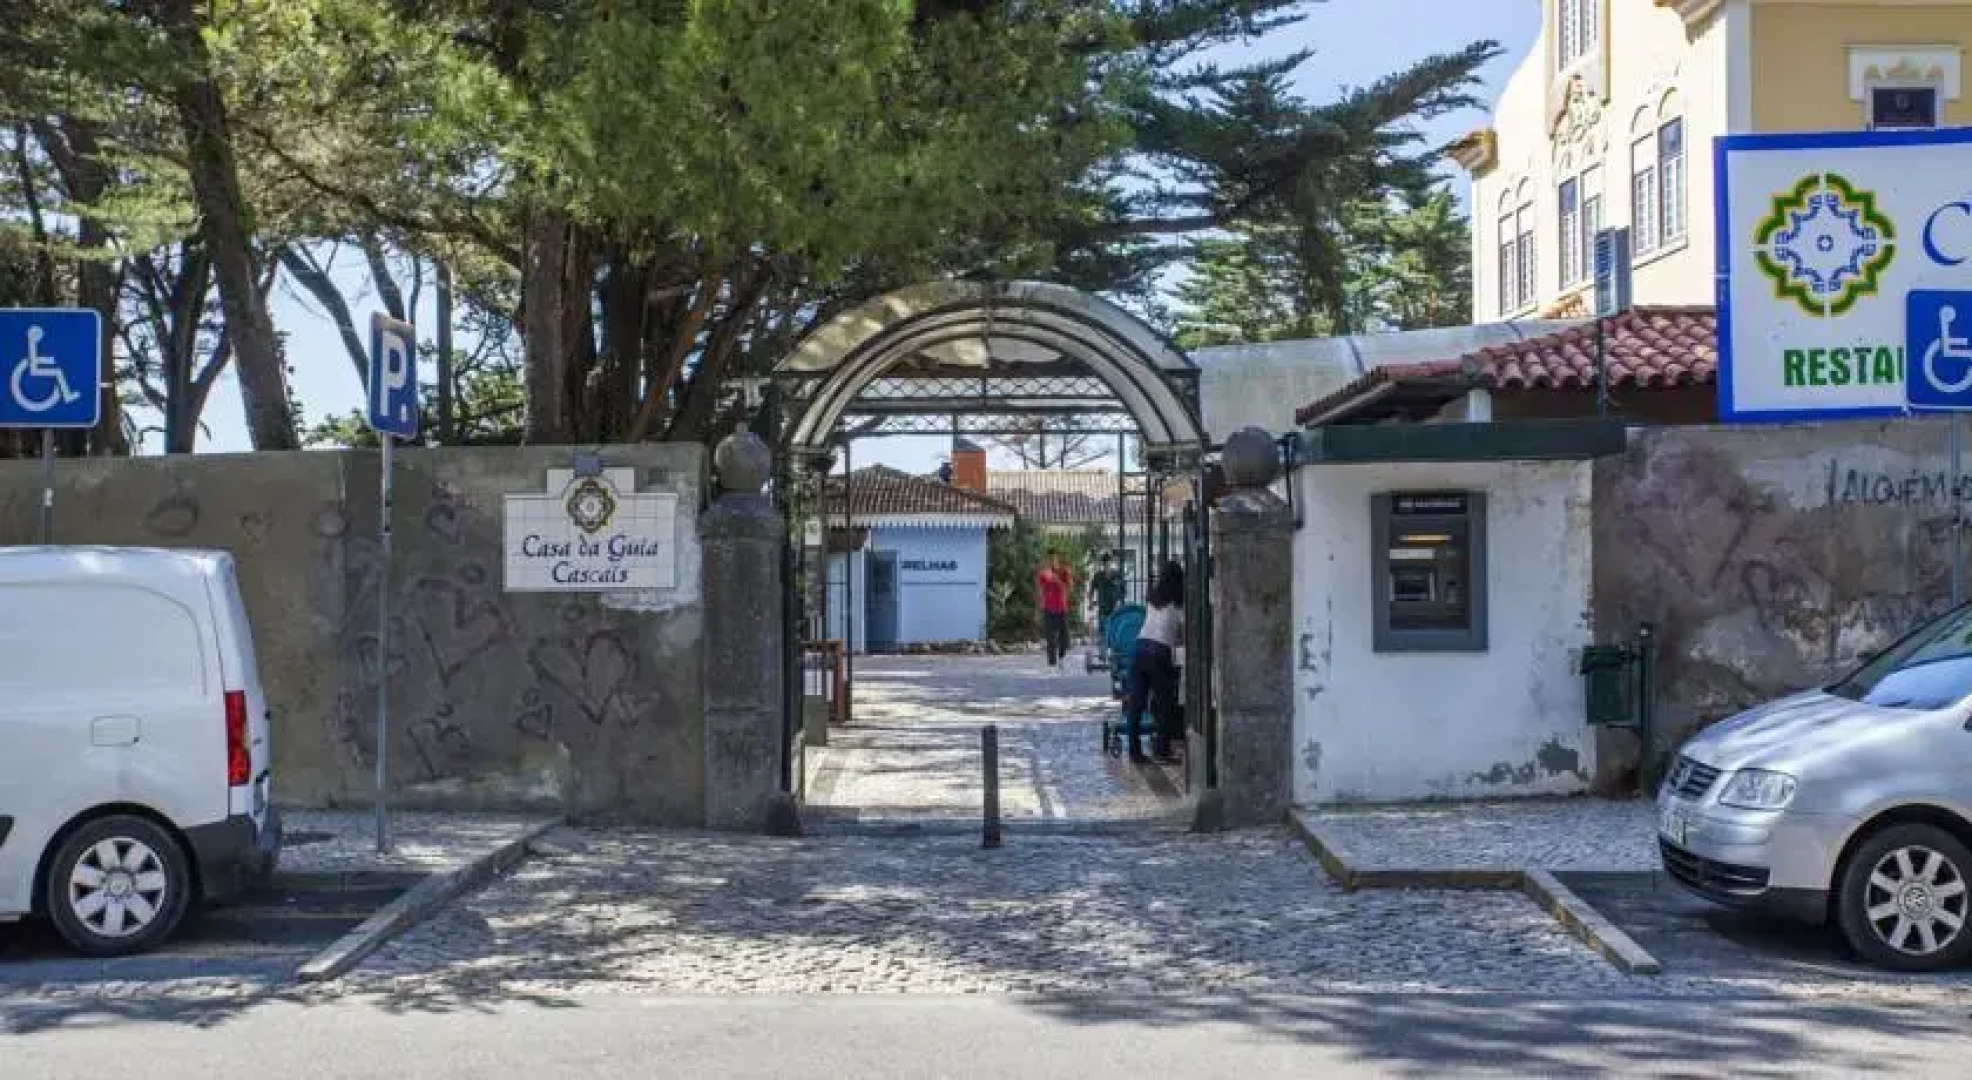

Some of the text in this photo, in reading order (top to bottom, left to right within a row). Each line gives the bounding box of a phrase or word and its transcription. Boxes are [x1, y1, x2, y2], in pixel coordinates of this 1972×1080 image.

[1783, 347, 1904, 386] RESTA
[522, 533, 658, 562] Casa da Guia
[552, 560, 628, 583] Cascais
